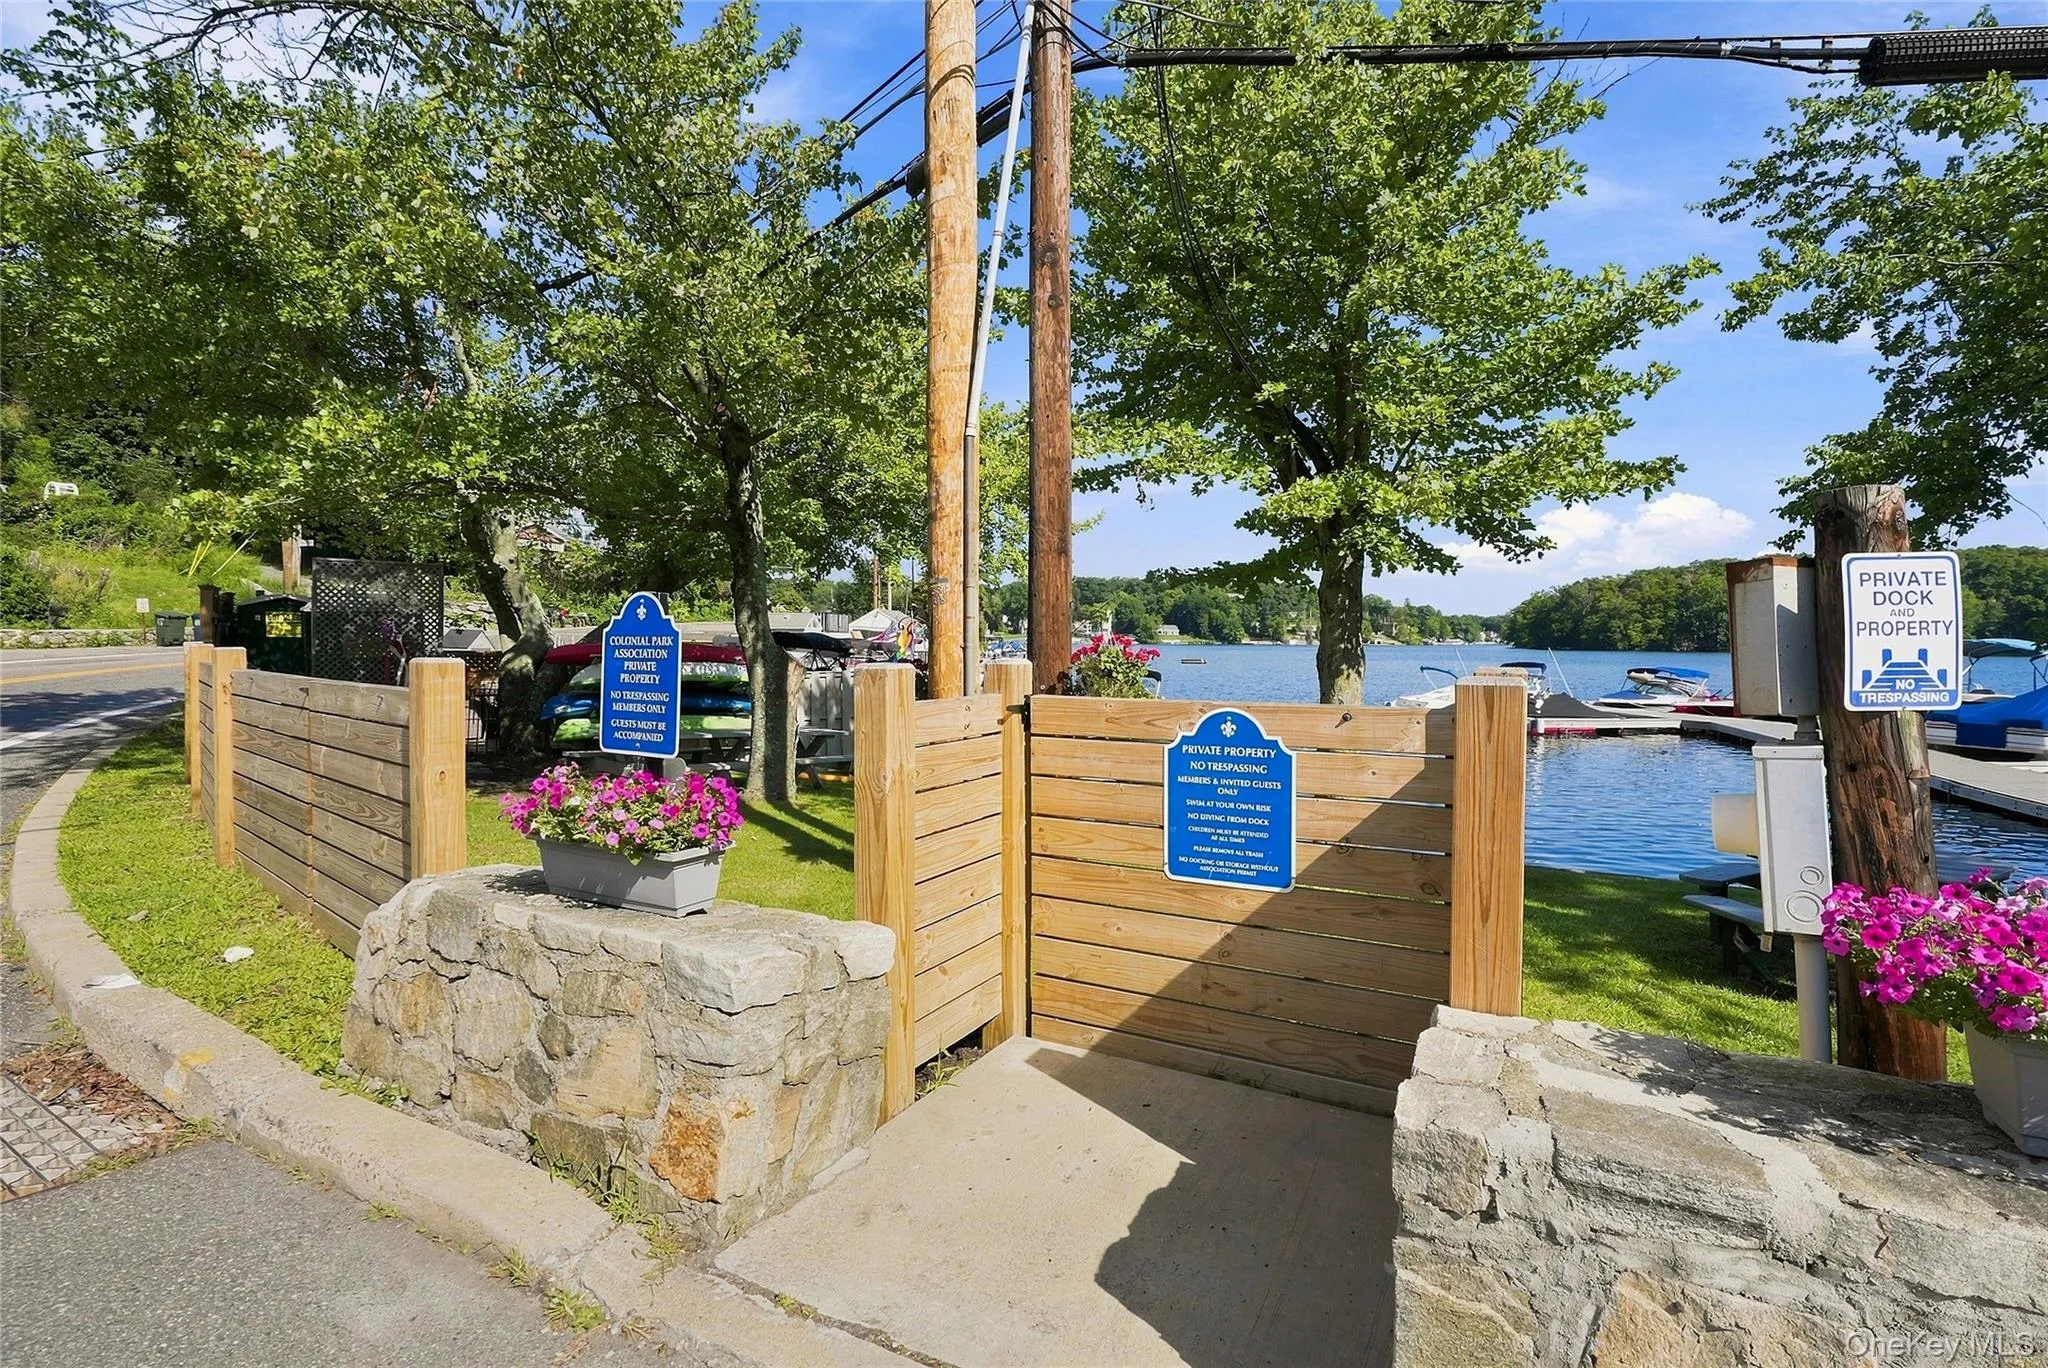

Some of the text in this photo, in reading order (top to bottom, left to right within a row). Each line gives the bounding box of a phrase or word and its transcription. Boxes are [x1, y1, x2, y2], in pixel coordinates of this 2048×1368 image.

[1860, 571, 1947, 587] PRIVATE
[1873, 590, 1933, 606] DOCK
[1890, 608, 1915, 617] AND
[1856, 620, 1953, 636] PROPERTY
[610, 636, 673, 646] COLONIAL PARK
[614, 649, 667, 658] ASSOCIATION
[624, 662, 656, 671] PRIVATE
[620, 674, 660, 684] PROPERTY
[1896, 679, 1915, 689] NO
[623, 692, 669, 701] TRESPASSING
[1860, 692, 1949, 703] TRESPASSING
[613, 703, 666, 713] MEMBERS ONLY
[611, 719, 666, 730] GUESTS MUST BE
[614, 731, 663, 741] ACCOMPANIED
[1182, 745, 1276, 758] PRIVATE PROPERTY
[1190, 761, 1268, 773] NO TRESPASSING
[1178, 776, 1211, 784] MEMBERS
[1221, 779, 1250, 787] INVITED
[1253, 780, 1281, 789] GUESTS
[1215, 801, 1234, 809] YOUR
[1200, 814, 1225, 822] DIVING
[1227, 816, 1247, 824] FROM
[1248, 818, 1269, 826] DOCK
